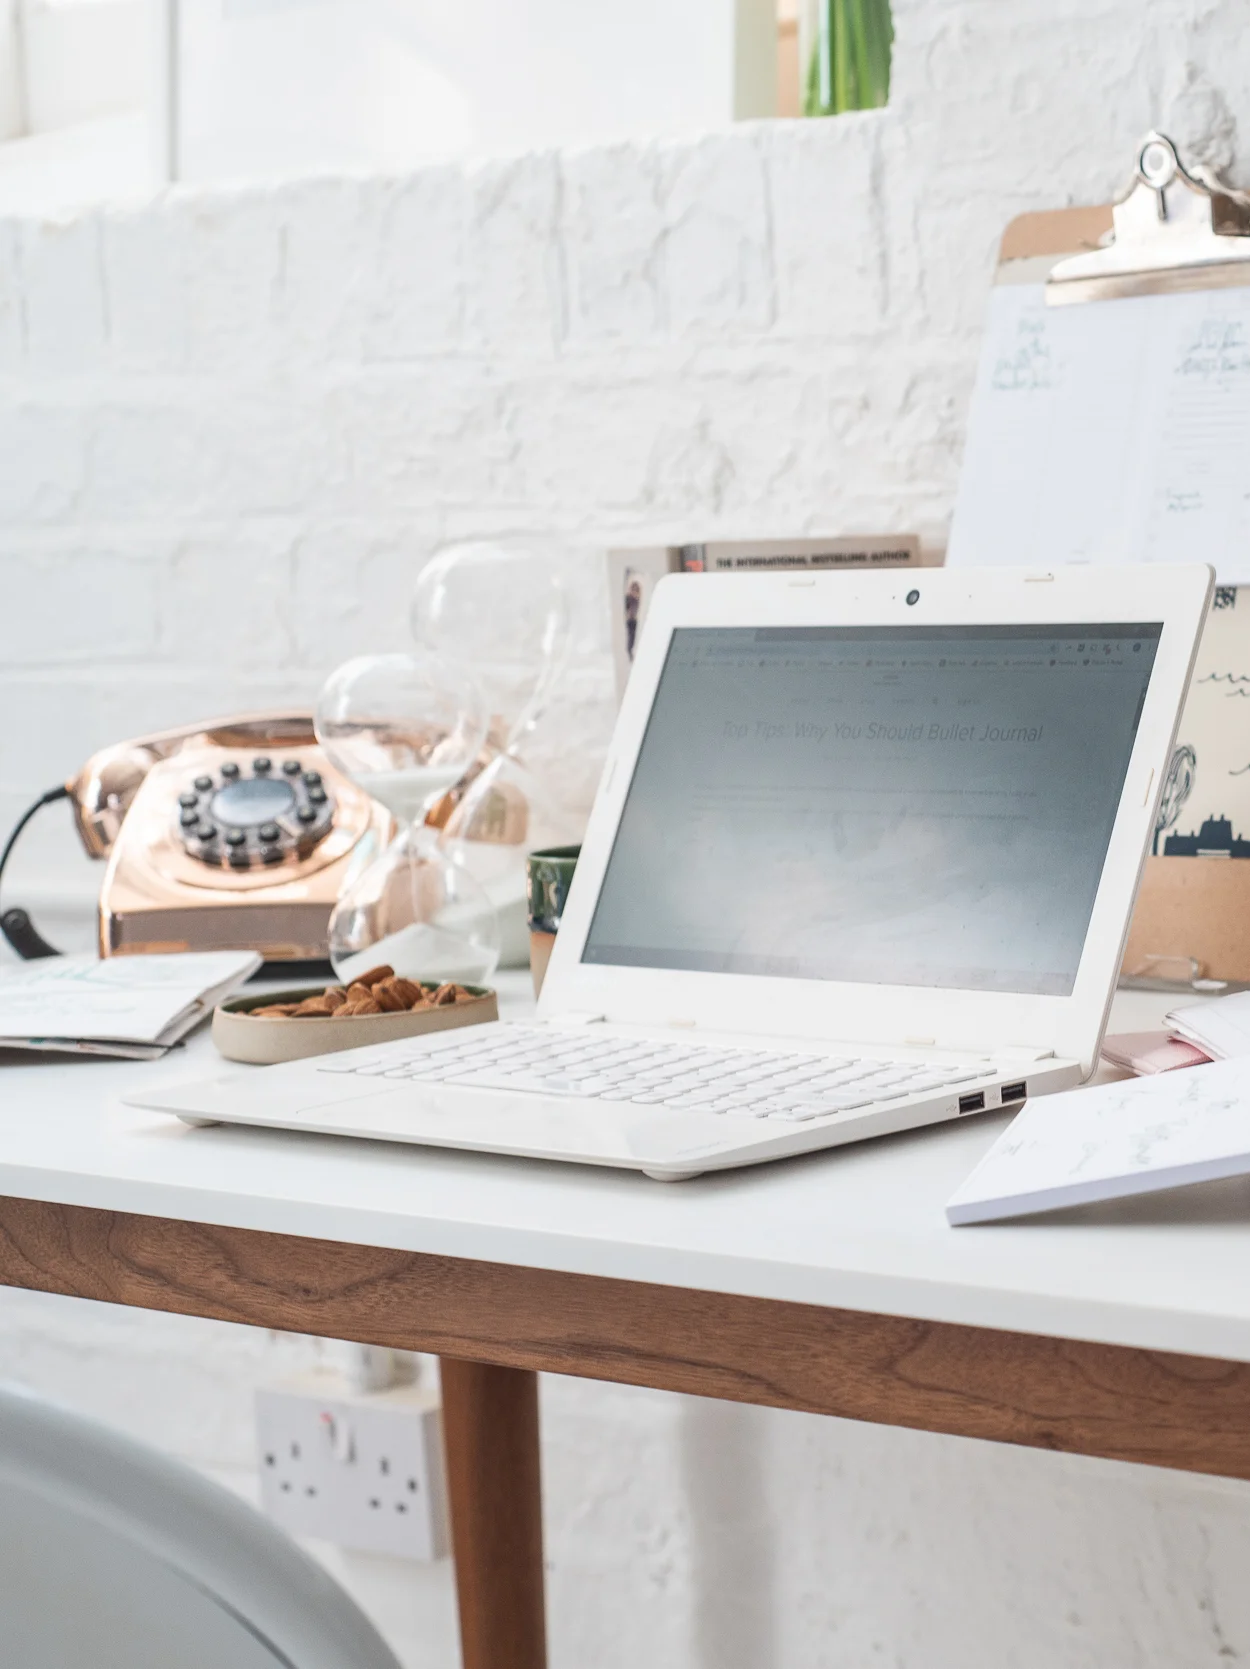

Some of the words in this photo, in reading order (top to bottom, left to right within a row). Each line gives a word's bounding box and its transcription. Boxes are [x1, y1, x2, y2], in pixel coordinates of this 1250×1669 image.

[794, 721, 829, 744] Why
[834, 721, 862, 741] You
[865, 721, 924, 742] Should
[927, 723, 976, 742] Bullet
[979, 724, 1044, 743] Journal
